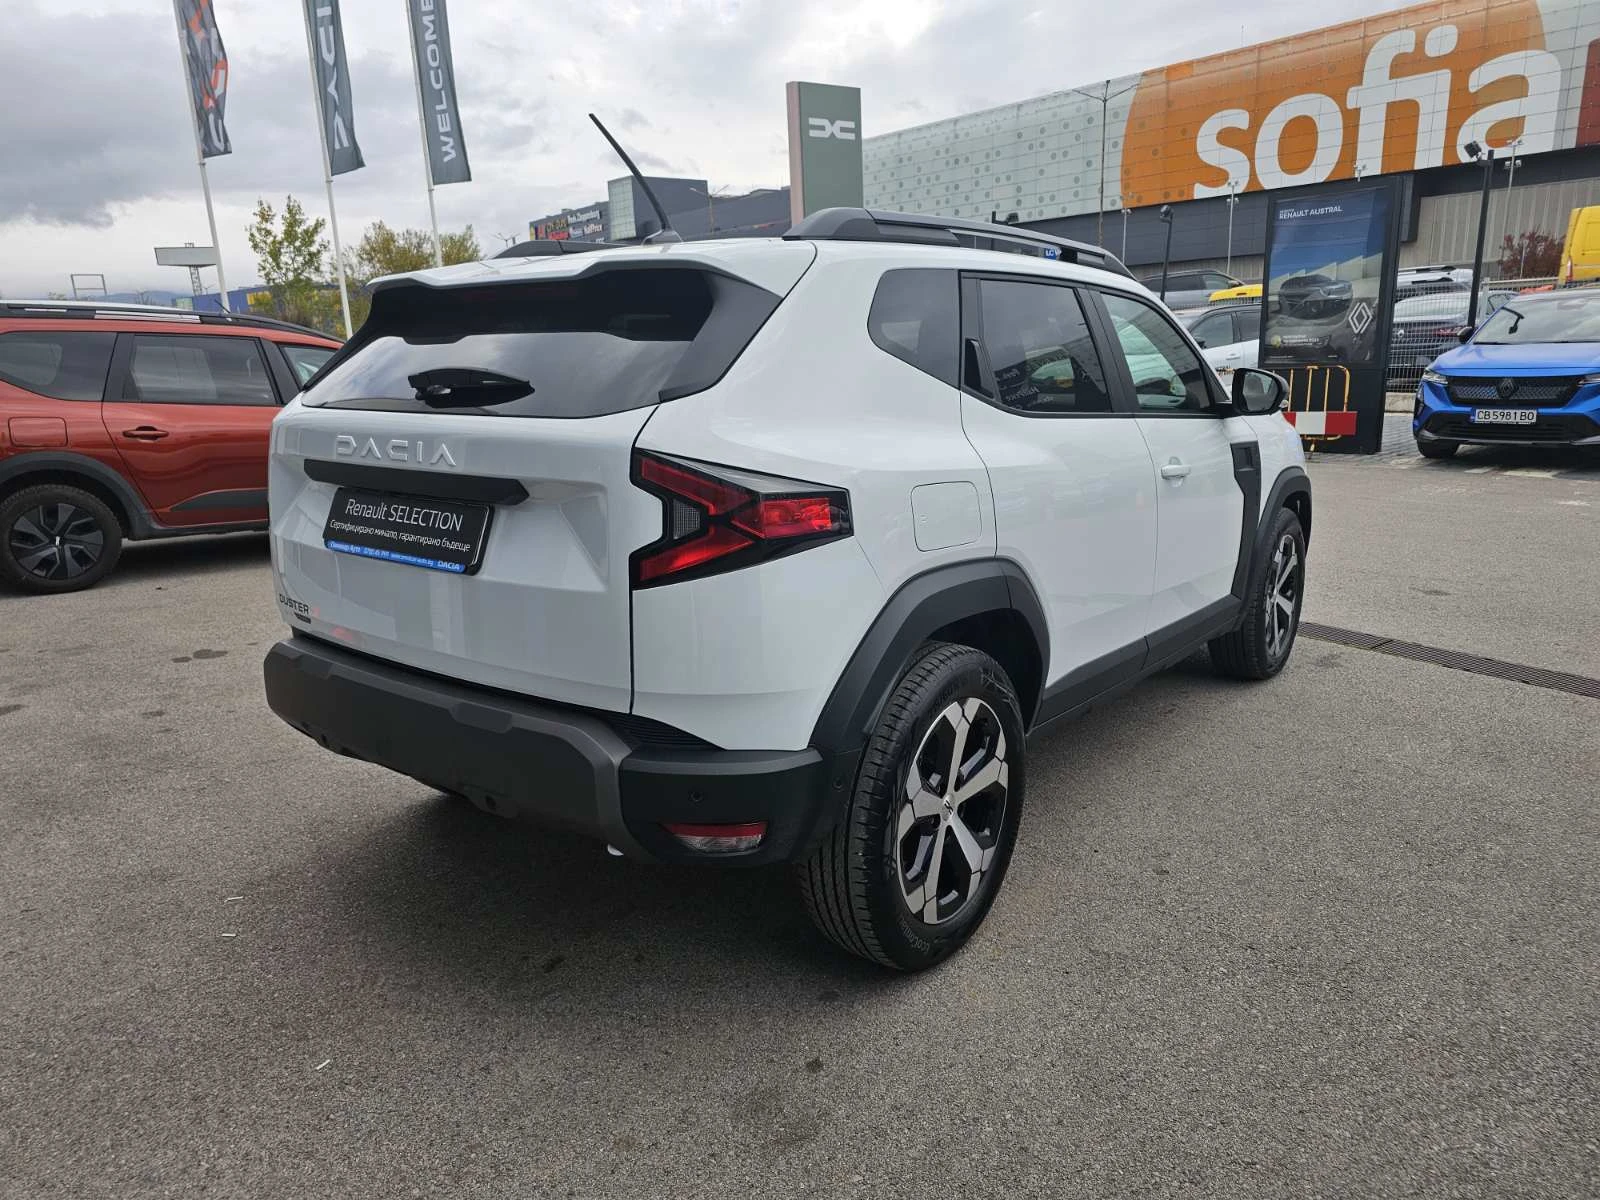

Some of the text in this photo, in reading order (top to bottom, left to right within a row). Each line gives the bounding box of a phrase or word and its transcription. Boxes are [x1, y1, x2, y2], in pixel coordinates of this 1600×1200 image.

[1194, 24, 1562, 200] sofia
[1279, 210, 1309, 219] RENAULT
[1310, 204, 1344, 216] AUSTRAL
[335, 434, 457, 468] DACIA
[345, 498, 464, 532] Renault SELECTION
[329, 519, 375, 536] Сертифицирано
[399, 531, 442, 547] гарантирано
[441, 537, 472, 553] бъдеще
[437, 560, 460, 570] DACIA
[279, 594, 309, 615] DUSTER
